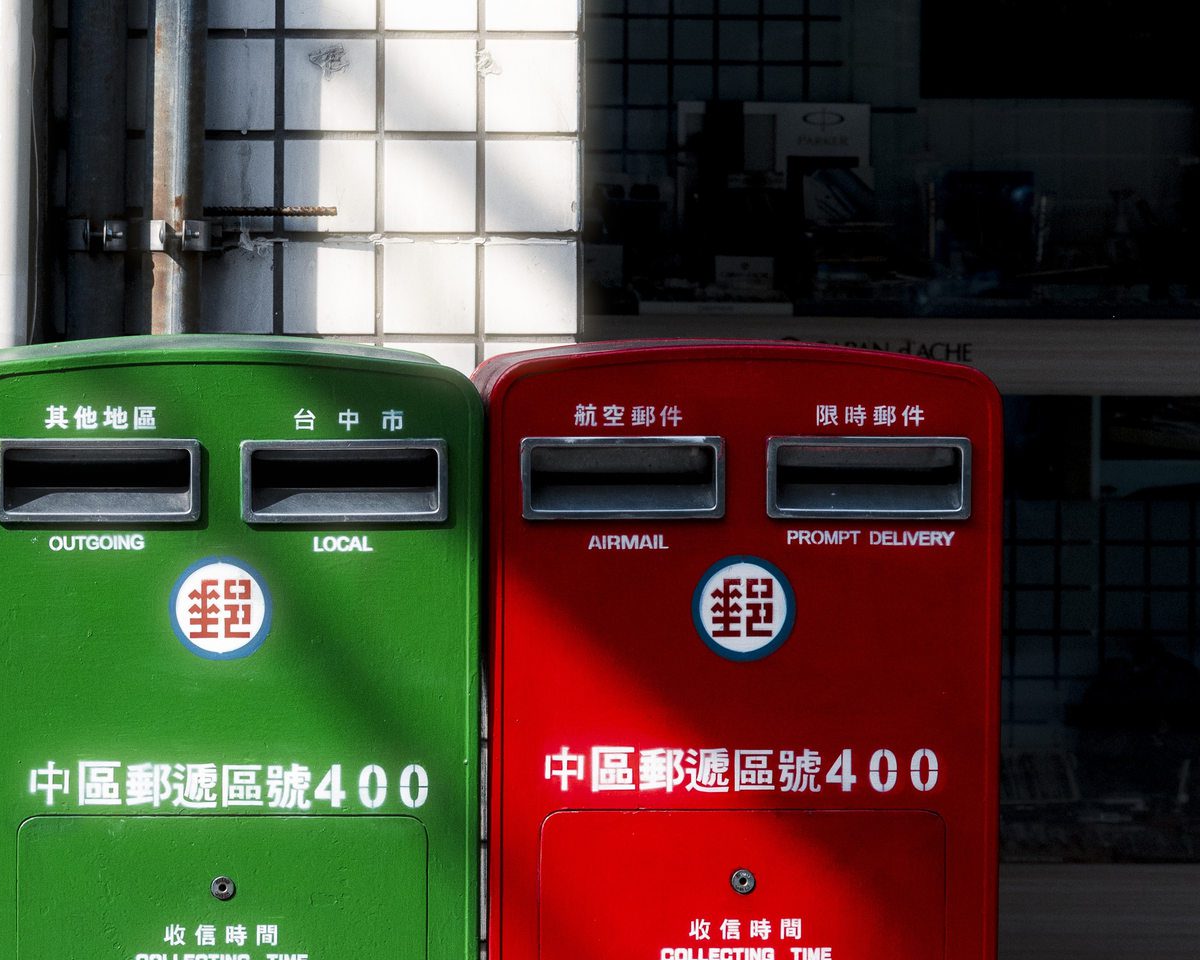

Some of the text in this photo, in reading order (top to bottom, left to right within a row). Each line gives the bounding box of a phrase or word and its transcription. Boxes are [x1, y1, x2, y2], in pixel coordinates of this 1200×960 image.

[798, 136, 849, 146] PARKER
[44, 405, 157, 431] 其他地區
[293, 408, 404, 432] 台中市
[573, 403, 684, 428] 航空郵件
[815, 404, 926, 427] 限時郵件
[48, 534, 145, 551] OUTGOING
[313, 536, 373, 552] LOCAL
[587, 535, 669, 551] AIRMAIL
[786, 530, 956, 547] PROMPT DELIVERY
[163, 924, 279, 947] 收信時間
[688, 918, 803, 941] 收信時間
